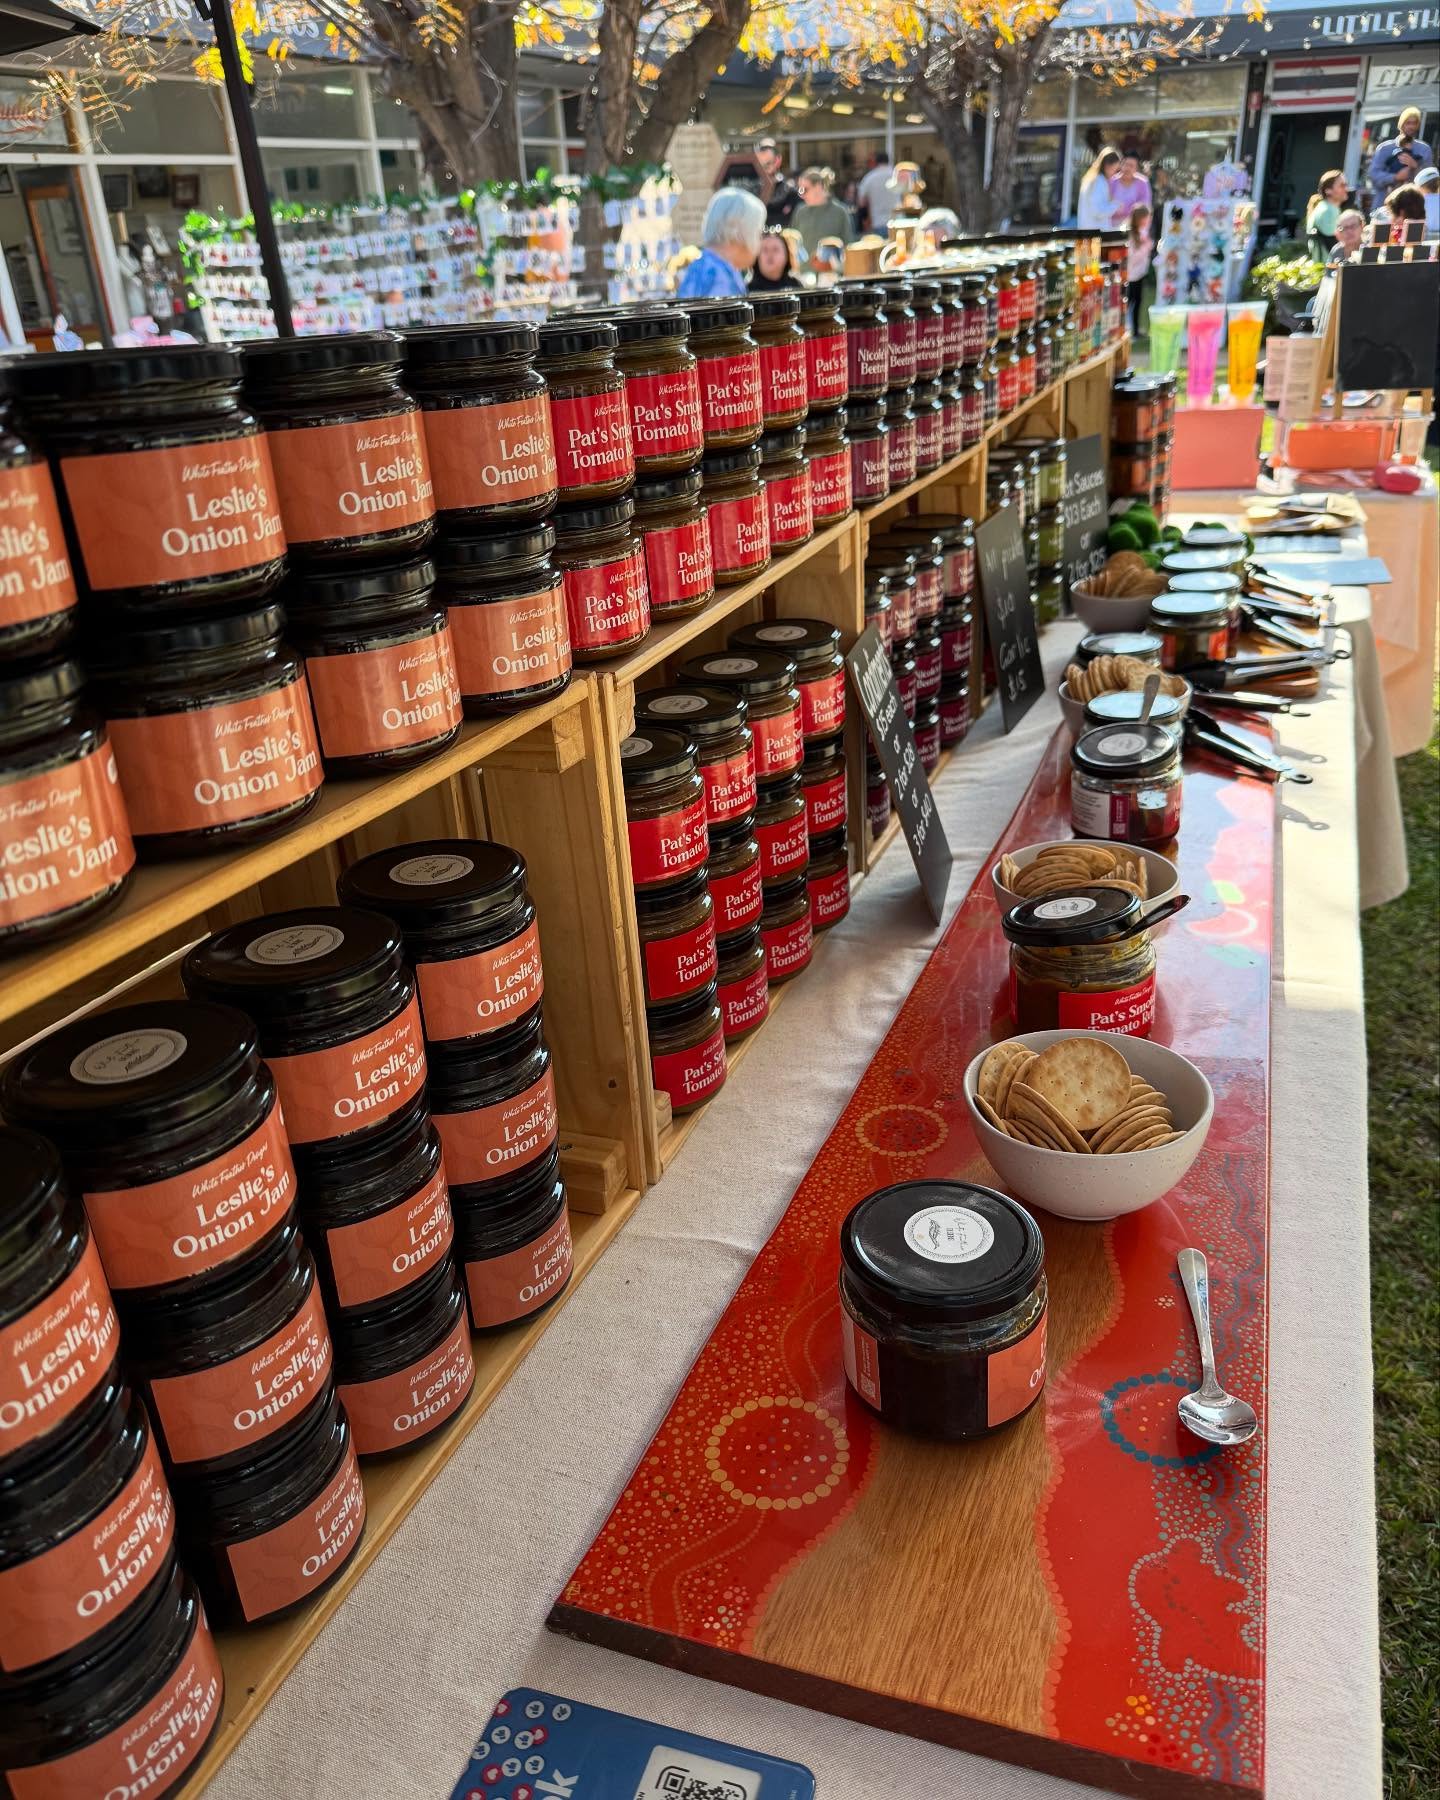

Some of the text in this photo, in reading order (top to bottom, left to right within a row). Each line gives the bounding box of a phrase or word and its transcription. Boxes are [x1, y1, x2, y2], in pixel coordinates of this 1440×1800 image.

[1322, 11, 1403, 35] LITTLE
[772, 368, 798, 385] Pat's
[815, 358, 839, 373] Pat's
[707, 381, 740, 400] Pat's
[633, 403, 672, 423] Pat's
[706, 399, 753, 418] Tomato
[357, 437, 378, 452] White
[568, 426, 608, 449] Pat's
[632, 422, 689, 442] Tomato
[500, 432, 551, 461] Leslie's
[567, 447, 625, 470] Tomato
[182, 464, 209, 483] White
[360, 455, 423, 487] Leslie's
[481, 461, 539, 487] Onion
[1074, 469, 1104, 495] Sauces
[186, 483, 267, 523] Leslie's
[338, 479, 433, 516] Onion Jam
[774, 500, 800, 517] Pat's
[1064, 493, 1102, 528] $13 Each
[162, 511, 282, 557] Onion Jam
[737, 521, 762, 539] Pat's
[30, 555, 71, 590] Jam
[679, 550, 706, 569] Pat's
[585, 592, 624, 614] Pat's
[585, 608, 639, 633] Tomato
[511, 622, 563, 652] Leslie's
[1000, 631, 1031, 671] Garlic
[492, 652, 549, 677] Onion
[401, 667, 455, 704] Leslie's
[853, 637, 893, 719] Condiments
[1007, 669, 1027, 703] $15
[382, 702, 443, 730] Onion
[811, 706, 844, 724] Tomato
[812, 696, 836, 712] Pat's
[876, 691, 898, 742] $15 each
[214, 719, 243, 738] White
[218, 728, 303, 774] Leslie's
[764, 744, 801, 765] Tomato
[766, 734, 791, 752] Pat's
[893, 733, 901, 754] or
[194, 749, 317, 805] Onion Jam
[894, 741, 916, 801] 2 for $28
[710, 791, 751, 813] Tomato
[711, 780, 740, 799] Pat's
[912, 787, 919, 809] or
[812, 806, 845, 824] Tomato
[813, 798, 836, 812] Pat's
[912, 792, 933, 856] 3 for $40
[68, 834, 119, 878] Jam
[659, 843, 703, 869] Tomato
[660, 831, 691, 855] Pat's
[771, 838, 796, 855] Pat's
[770, 846, 805, 867] Tomato
[724, 897, 760, 922] Tomato
[725, 890, 751, 909] Pat's
[817, 890, 841, 906] Pat's
[676, 948, 705, 970] Pat's
[769, 946, 808, 970] Tomato
[770, 940, 797, 957] Pat's
[494, 952, 539, 995] Leslie's
[675, 956, 716, 984] Tomato
[476, 988, 528, 1018] Onion
[726, 1002, 765, 1027] Tomato
[727, 994, 755, 1014] Pat's
[1090, 1010, 1126, 1025] Pat's
[351, 1047, 374, 1066] White
[354, 1041, 416, 1092] Leslie's
[683, 1069, 722, 1095] Tomato
[684, 1060, 712, 1083] Pat's
[333, 1051, 426, 1119] Onion Jam
[503, 1101, 552, 1143] Leslie's
[485, 1136, 538, 1166] Onion
[191, 1177, 219, 1199] White
[194, 1165, 276, 1227] Leslie's
[172, 1169, 291, 1259] Onion Jam
[408, 1193, 451, 1246] Leslie's
[391, 1232, 443, 1273] Onion
[534, 1236, 571, 1281] Leslie's
[518, 1269, 563, 1302] Onion
[18, 1301, 101, 1390] Leslie's
[0, 1358, 87, 1431] Onion
[89, 1305, 116, 1362] Jam
[254, 1333, 320, 1402] Leslie's
[411, 1353, 465, 1408] Leslie's
[232, 1381, 305, 1432] Onion
[307, 1333, 330, 1383] Jam
[392, 1391, 451, 1432] Onion
[317, 1473, 361, 1546] Leslie's
[96, 1487, 163, 1579] Leslie's
[301, 1515, 354, 1577] Onion
[76, 1542, 154, 1618] Onion
[104, 1743, 187, 1800] Onion
[188, 1676, 218, 1739] Jam
[125, 1681, 204, 1776] Leslie's
